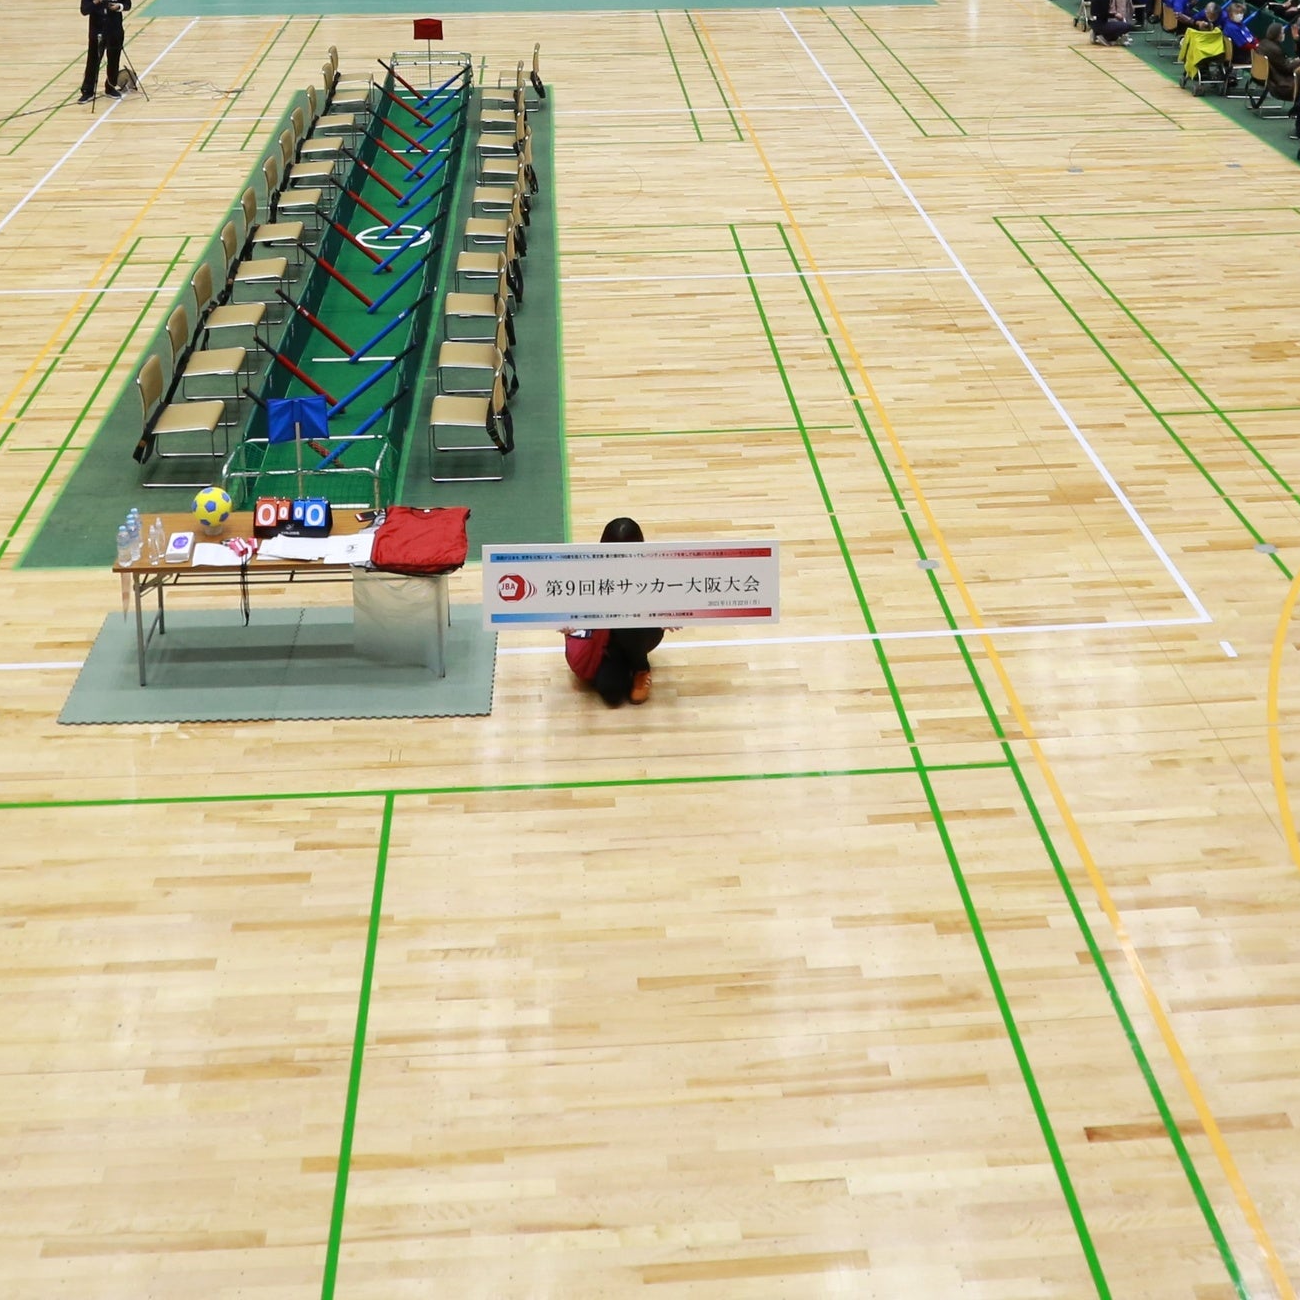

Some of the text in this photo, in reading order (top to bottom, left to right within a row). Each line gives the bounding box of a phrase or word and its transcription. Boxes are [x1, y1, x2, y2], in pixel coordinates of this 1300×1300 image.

[257, 503, 324, 526] 0 0 0 0
[500, 582, 517, 591] JBA
[545, 574, 761, 597] 第9回棒サッカー大阪大会
